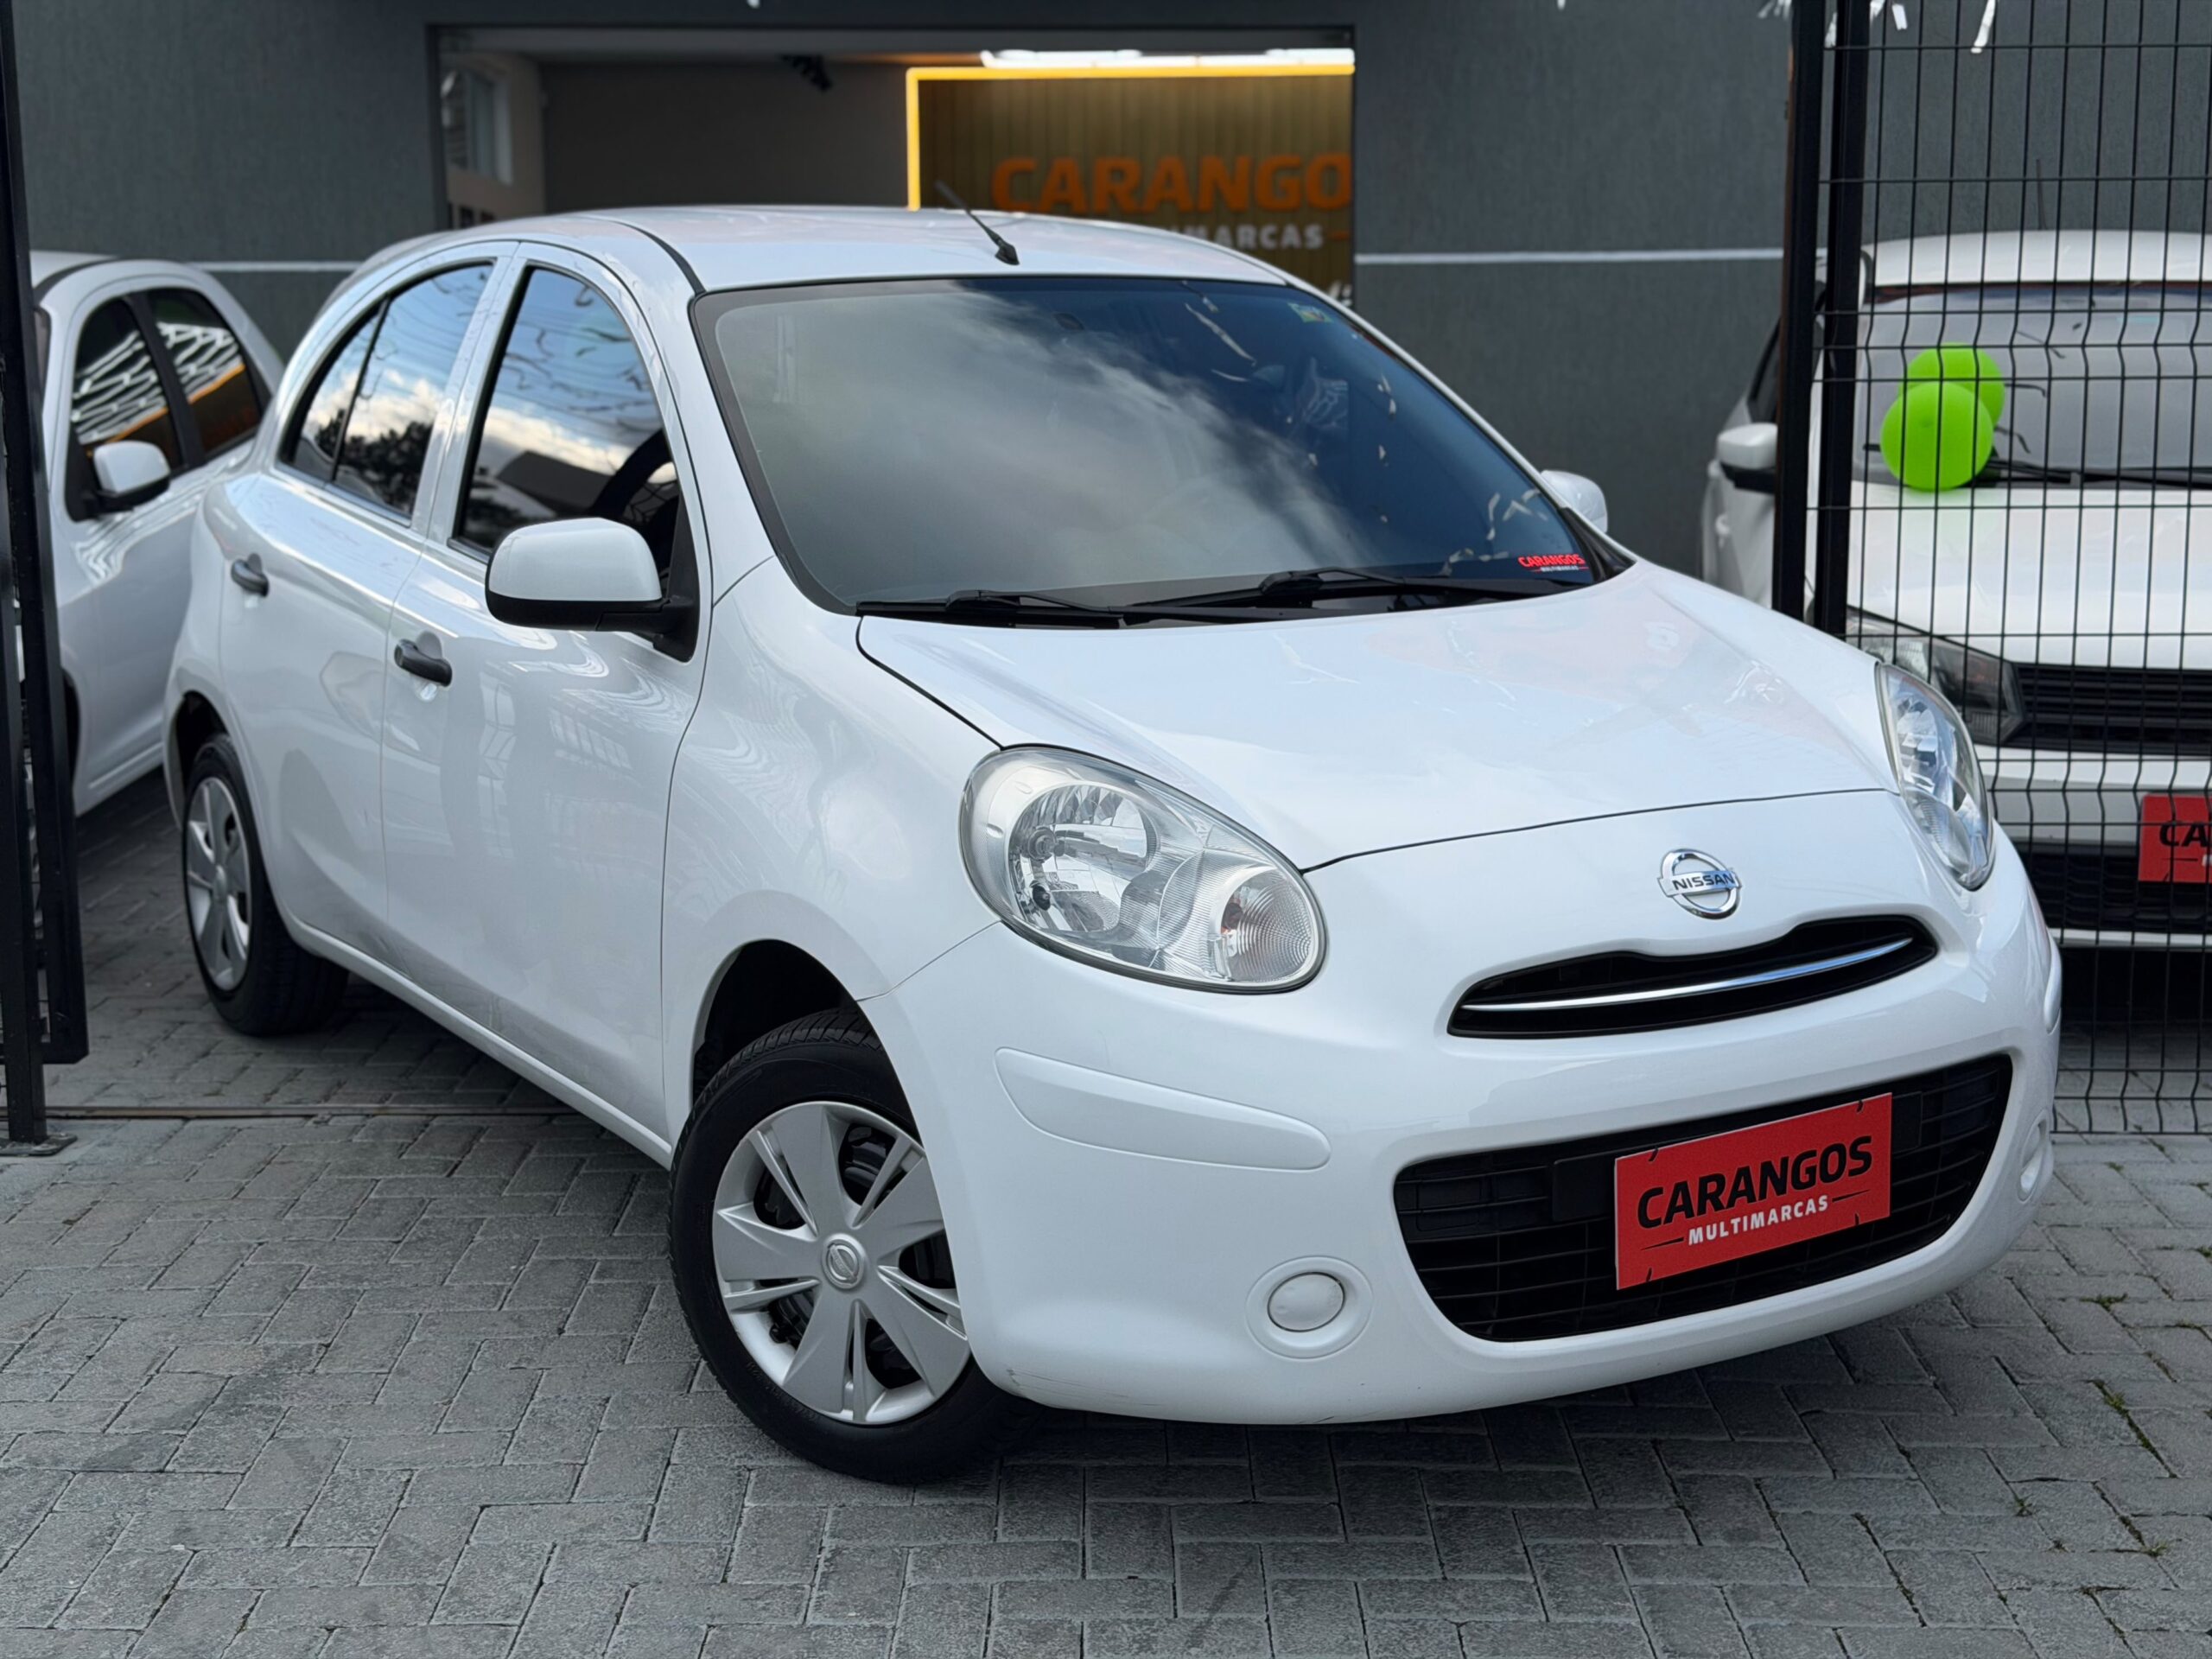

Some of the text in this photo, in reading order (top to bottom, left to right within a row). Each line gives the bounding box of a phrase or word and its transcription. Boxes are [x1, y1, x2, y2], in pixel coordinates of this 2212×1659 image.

[1172, 223, 1324, 249] ARCAS
[1518, 554, 1586, 567] CARANGOS
[1672, 873, 1736, 890] NISSAN
[1637, 1135, 1872, 1229] CARANGOS
[1688, 1195, 1829, 1245] MULTIMARCAS
